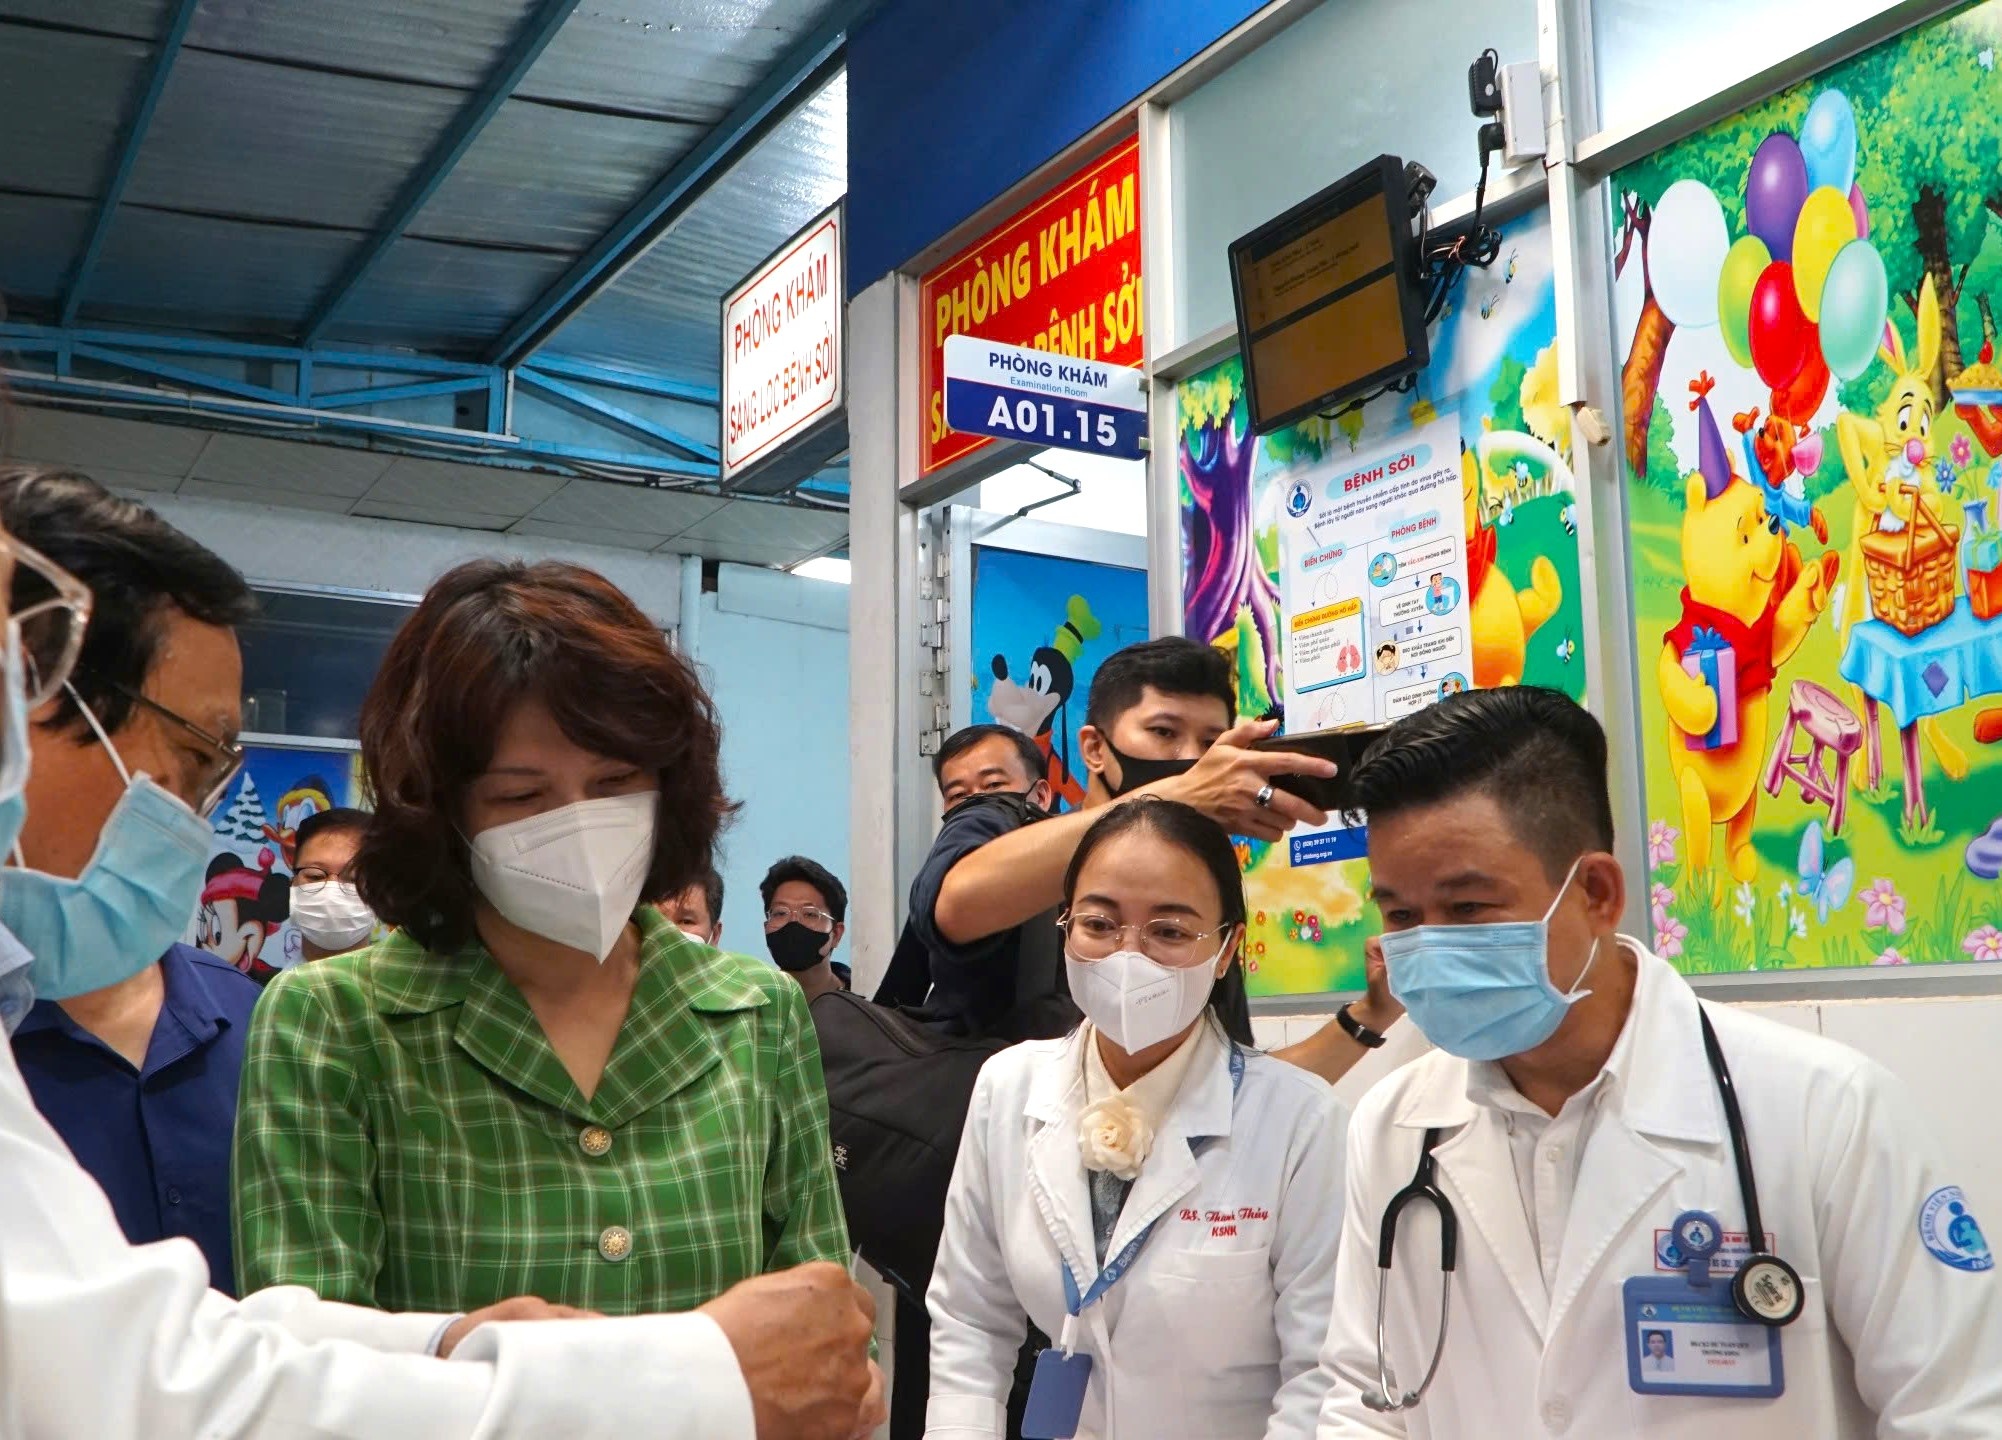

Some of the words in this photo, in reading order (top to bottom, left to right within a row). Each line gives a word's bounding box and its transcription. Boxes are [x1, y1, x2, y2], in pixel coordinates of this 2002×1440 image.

[936, 241, 1031, 346] PHÒNG
[1040, 173, 1135, 285] KHÁM
[735, 298, 781, 363] PHÒNG
[786, 252, 827, 323] KHÁM
[760, 375, 780, 425] LỌC
[783, 352, 812, 410] BỆNH
[815, 322, 833, 385] SỞI
[989, 352, 1052, 378] PHÒNG
[1059, 364, 1108, 387] KHÁM
[1011, 377, 1062, 393] Examination
[1064, 383, 1087, 398] Room
[988, 396, 1117, 447] A01.15
[1344, 467, 1384, 492] BỆNH
[1388, 454, 1416, 475] SỞI
[1314, 519, 1326, 530] Bệnh
[1327, 516, 1335, 526] lây
[1335, 514, 1340, 522] từ
[1341, 509, 1355, 521] người
[1356, 506, 1365, 516] này
[1366, 502, 1378, 513] sang
[1379, 496, 1393, 508] người
[1394, 492, 1407, 501] khác
[1408, 488, 1418, 496] qua
[1420, 481, 1437, 493] đường
[1438, 477, 1445, 485] hô
[1446, 472, 1458, 482] hấp.
[1333, 505, 1343, 515] một
[1344, 501, 1355, 511] bệnh
[1356, 496, 1372, 507] truyền
[1373, 490, 1388, 501] nhiễm
[1389, 486, 1400, 496] cấp
[1419, 475, 1432, 484] virus
[1433, 471, 1443, 480] gây
[1391, 523, 1416, 539] PHÒNG
[1418, 516, 1437, 530] BỆNH
[1304, 554, 1318, 568] BIẾN
[1319, 548, 1343, 562] CHỨNG
[1425, 549, 1440, 561] PHÒNG
[1441, 547, 1452, 557] BỆNH
[1294, 618, 1304, 628] BIẾN
[1305, 612, 1321, 625] CHỨNG
[1322, 609, 1338, 620] ĐƯỜNG
[1339, 606, 1347, 615] HÔ
[1347, 603, 1357, 613] HẤP
[1393, 608, 1410, 617] THƯỜNG
[1423, 640, 1436, 649] TRANG
[1180, 1209, 1200, 1221] BS.
[1238, 1208, 1268, 1221] Thủy
